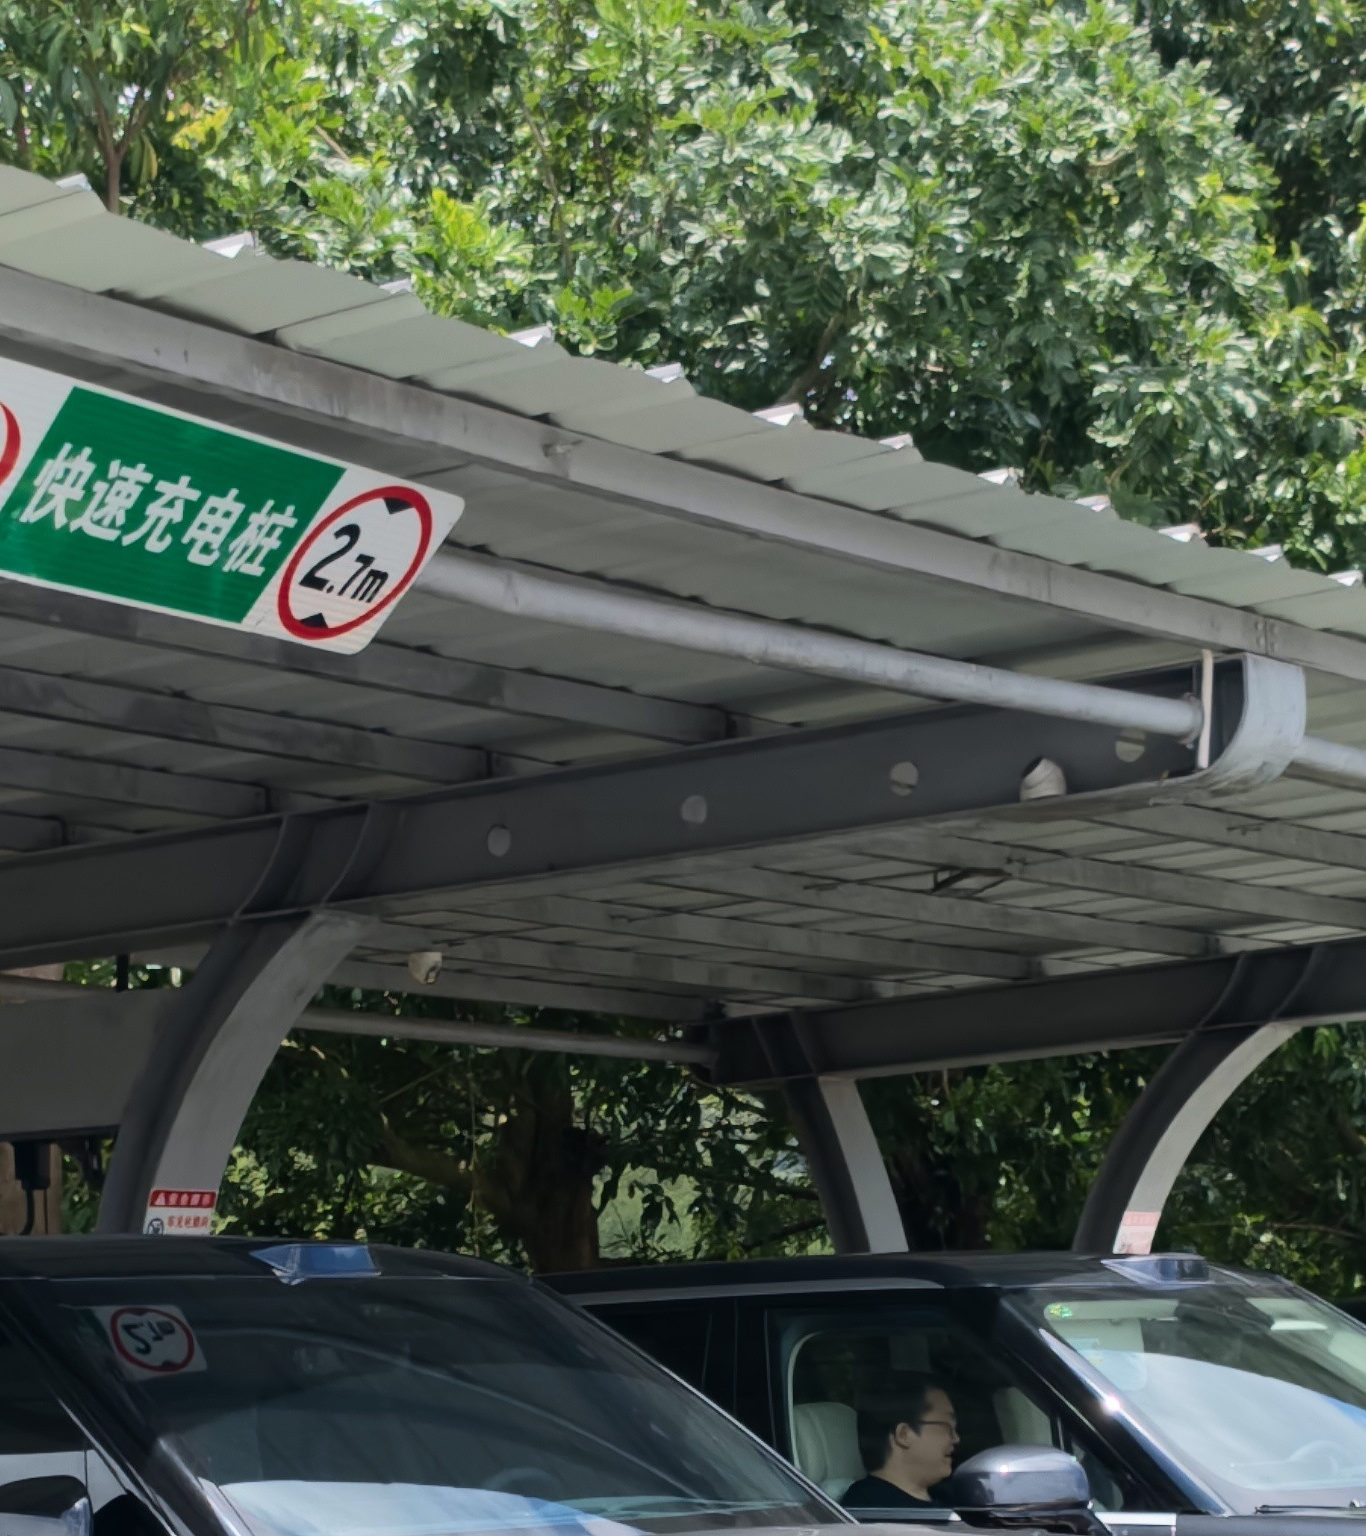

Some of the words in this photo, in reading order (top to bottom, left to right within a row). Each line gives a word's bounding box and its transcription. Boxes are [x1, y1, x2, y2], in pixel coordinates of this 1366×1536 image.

[19, 443, 298, 576] 快速充电桩
[299, 523, 389, 603] 2.7m
